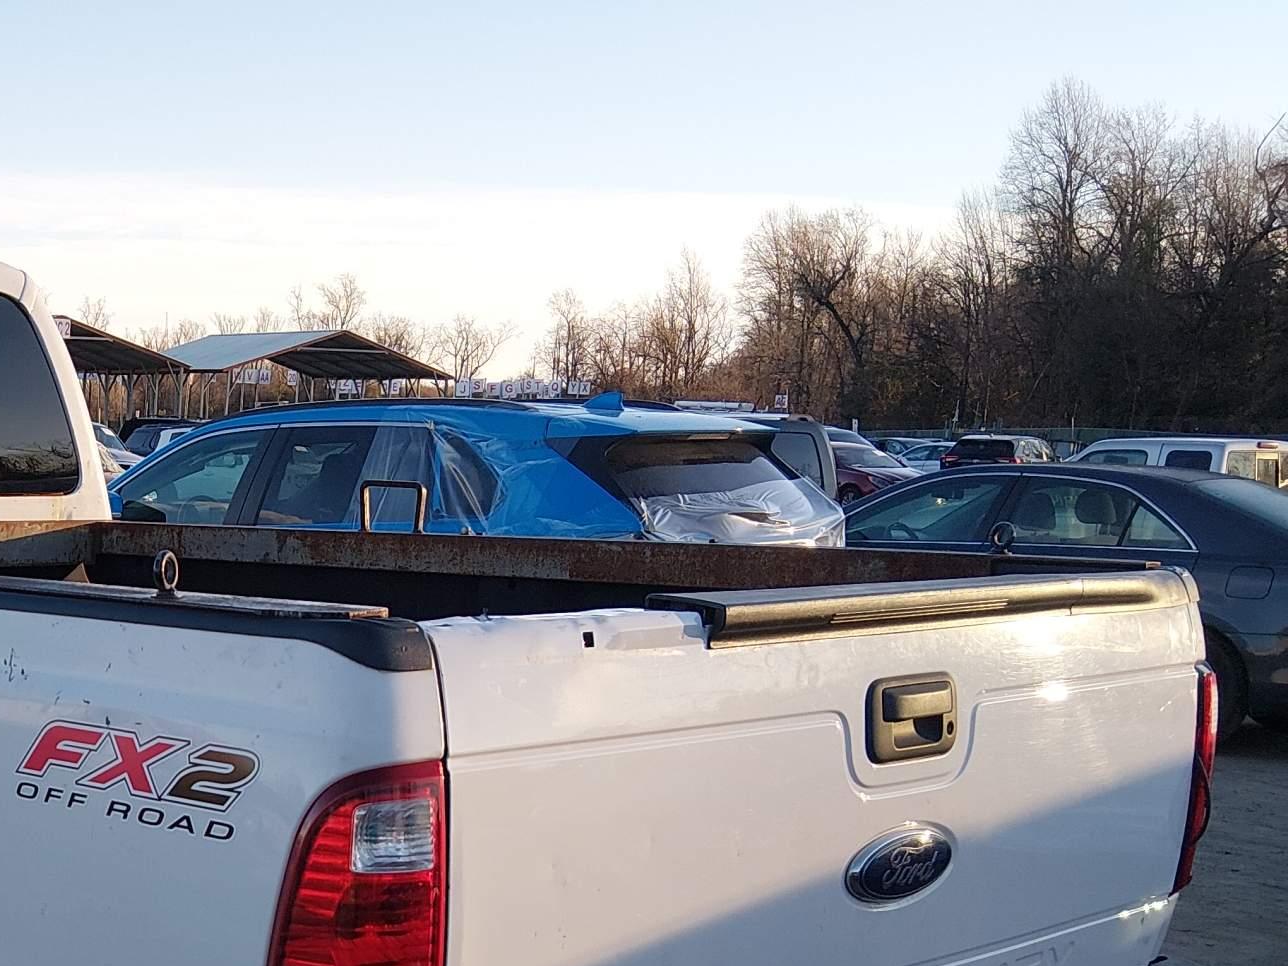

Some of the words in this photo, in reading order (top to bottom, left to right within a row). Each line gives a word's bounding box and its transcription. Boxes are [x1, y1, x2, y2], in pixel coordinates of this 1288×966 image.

[473, 380, 481, 391] S
[490, 384, 497, 393] F
[505, 383, 513, 393] G
[525, 380, 532, 390] S
[551, 382, 559, 393] Q
[582, 383, 588, 393] X
[15, 719, 261, 813] FX2
[15, 781, 89, 809] OFF
[105, 799, 236, 841] ROAD
